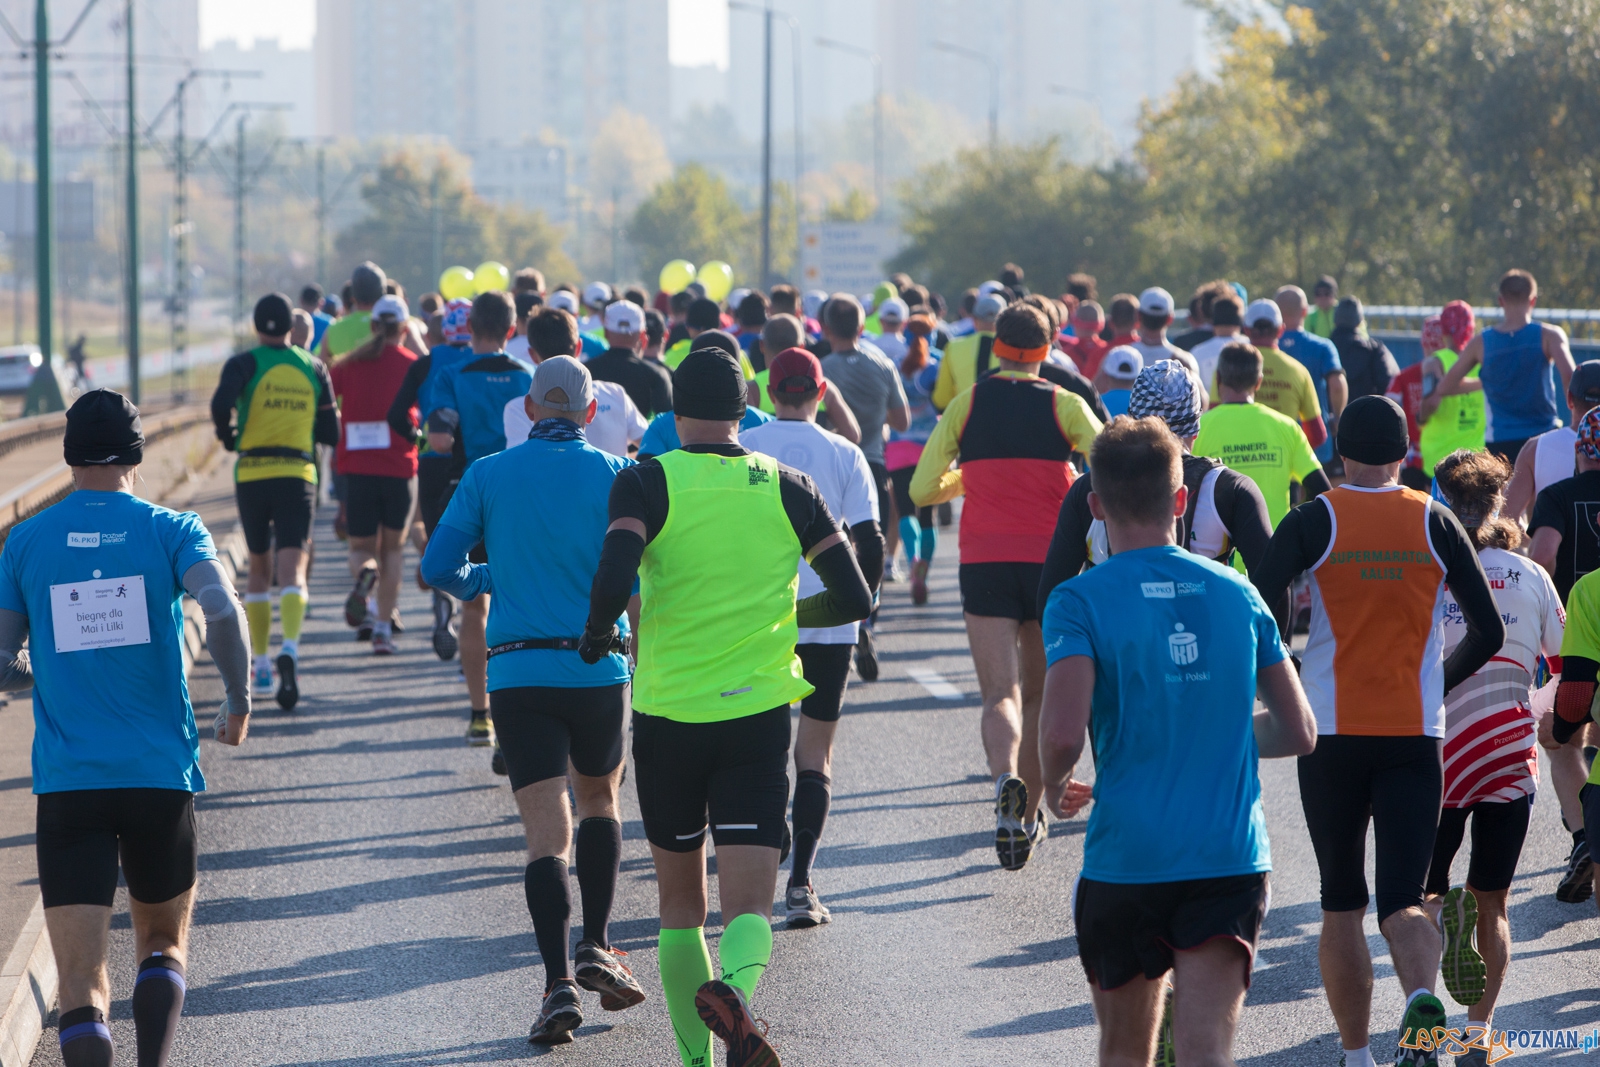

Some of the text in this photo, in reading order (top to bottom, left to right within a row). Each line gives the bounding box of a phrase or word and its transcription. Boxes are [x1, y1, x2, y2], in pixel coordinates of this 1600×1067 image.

[264, 398, 307, 411] ARTUR
[1223, 441, 1268, 453] RUNNERS
[81, 536, 98, 544] PKO
[1329, 549, 1432, 565] SUPERMARATON
[1361, 567, 1404, 580] KALISZ
[1155, 586, 1172, 594] PKO
[76, 608, 123, 623] biegnę dla
[81, 621, 124, 634] Mai i Lilki
[505, 642, 524, 651] SPORT
[1164, 671, 1211, 682] Bank Polski
